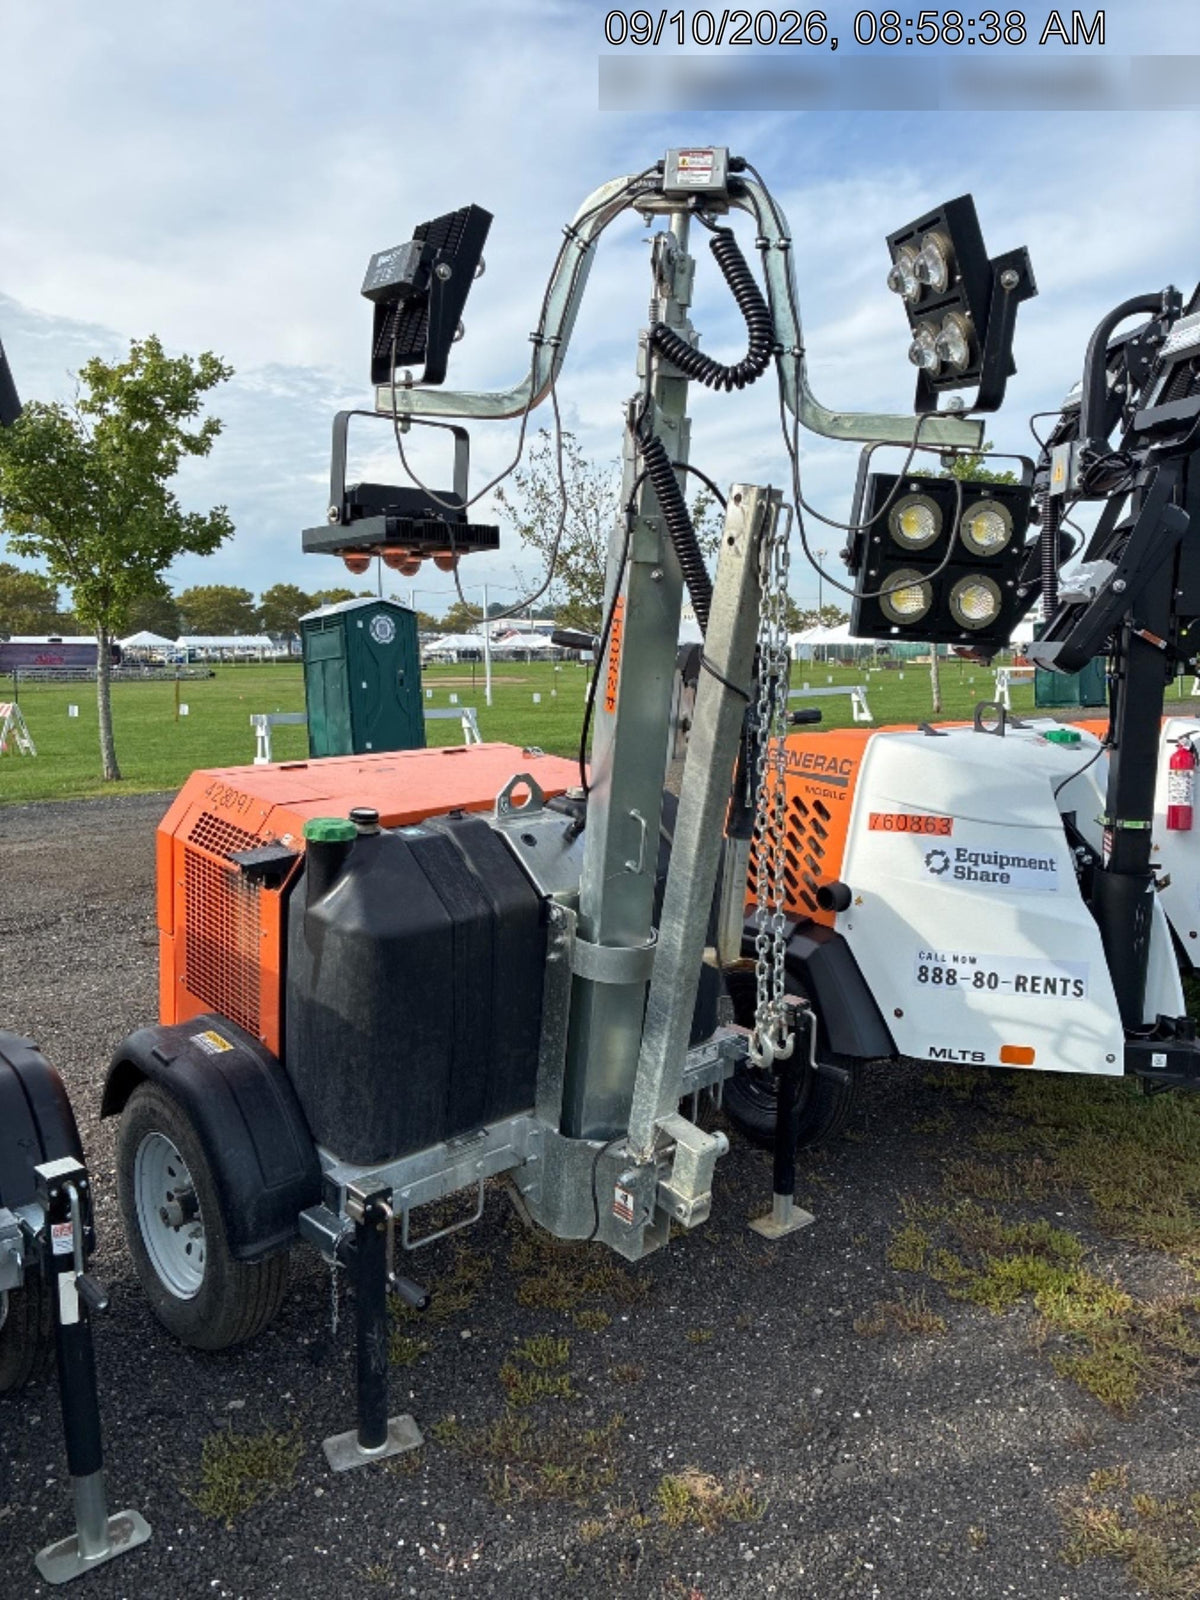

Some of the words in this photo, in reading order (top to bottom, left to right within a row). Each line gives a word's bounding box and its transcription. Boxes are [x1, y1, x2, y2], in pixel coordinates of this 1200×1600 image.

[204, 781, 255, 816] 428091
[804, 784, 848, 802] MOBILE
[871, 813, 951, 836] 760863
[954, 847, 1057, 873] Equipment
[953, 866, 1011, 885] Share
[918, 950, 947, 963] CALL
[952, 954, 977, 965] NOW
[916, 964, 1085, 998] 888-80-RENTS
